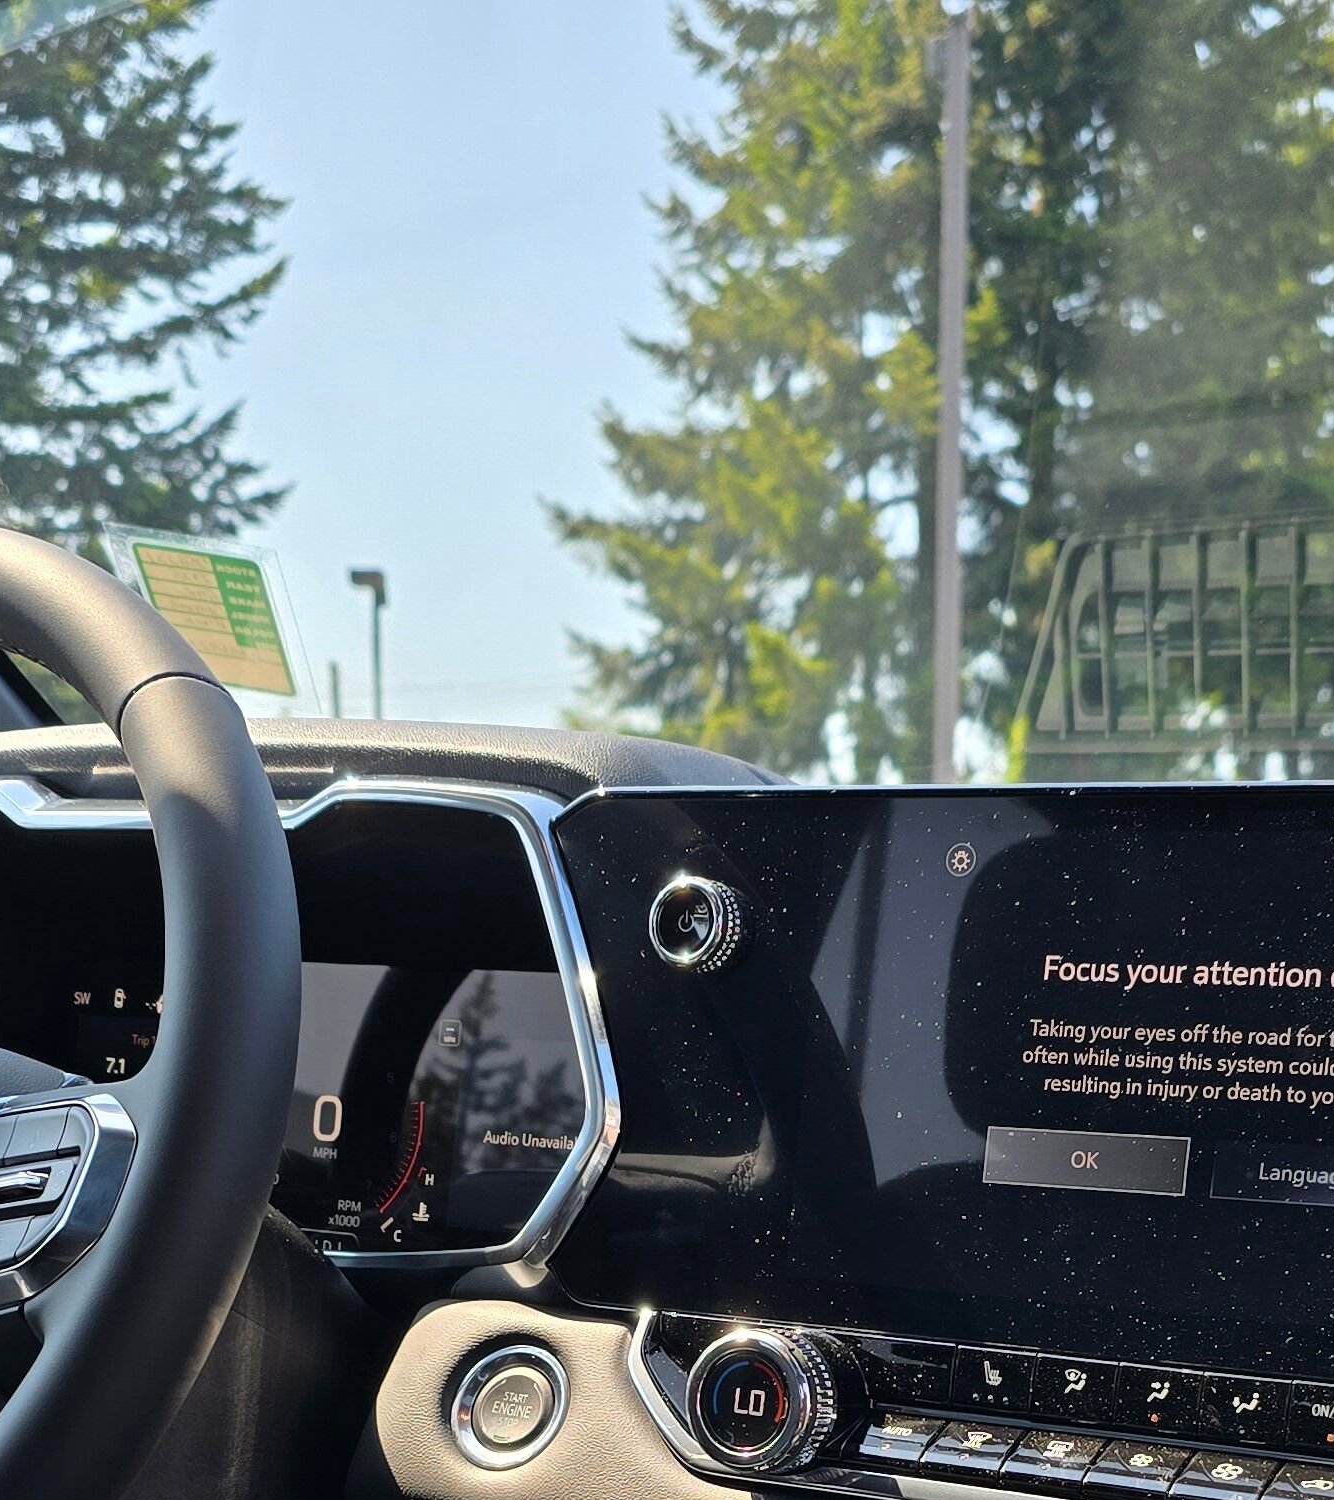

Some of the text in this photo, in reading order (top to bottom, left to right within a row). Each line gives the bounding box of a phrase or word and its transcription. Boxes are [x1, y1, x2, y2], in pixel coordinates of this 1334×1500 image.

[1043, 955, 1120, 983] Focus
[1123, 962, 1188, 991] your
[1193, 960, 1322, 988] attention
[73, 991, 92, 1005] SW
[131, 1033, 150, 1049] Trip
[1029, 1019, 1087, 1043] Taking
[1088, 1025, 1132, 1044] your
[1134, 1027, 1176, 1046] eyes
[1180, 1023, 1210, 1043] off
[1212, 1025, 1243, 1045] the
[1247, 1027, 1292, 1046] road
[1295, 1026, 1326, 1047] for
[105, 1057, 126, 1075] 7.1
[1022, 1045, 1069, 1065] often
[1073, 1048, 1121, 1067] while
[1124, 1051, 1174, 1074] using
[1178, 1052, 1213, 1071] this
[1216, 1056, 1284, 1077] system
[1043, 1074, 1122, 1100] resulting
[1125, 1077, 1143, 1096] in
[1146, 1078, 1199, 1103] injury
[1202, 1084, 1224, 1100] or
[1226, 1081, 1282, 1102] death
[1286, 1085, 1307, 1104] to
[312, 1094, 343, 1142] 0
[482, 1129, 577, 1151] Audio Unavaila
[312, 1147, 338, 1160] MPH
[1070, 1150, 1100, 1170] OK
[424, 1173, 435, 1186] H
[337, 1199, 362, 1212] RPM
[328, 1214, 361, 1228] x1000
[392, 1229, 402, 1243] C
[502, 1391, 529, 1404] START
[491, 1400, 533, 1419] ENGINE
[497, 1416, 520, 1428] STOP
[881, 1425, 913, 1437] AUTO
